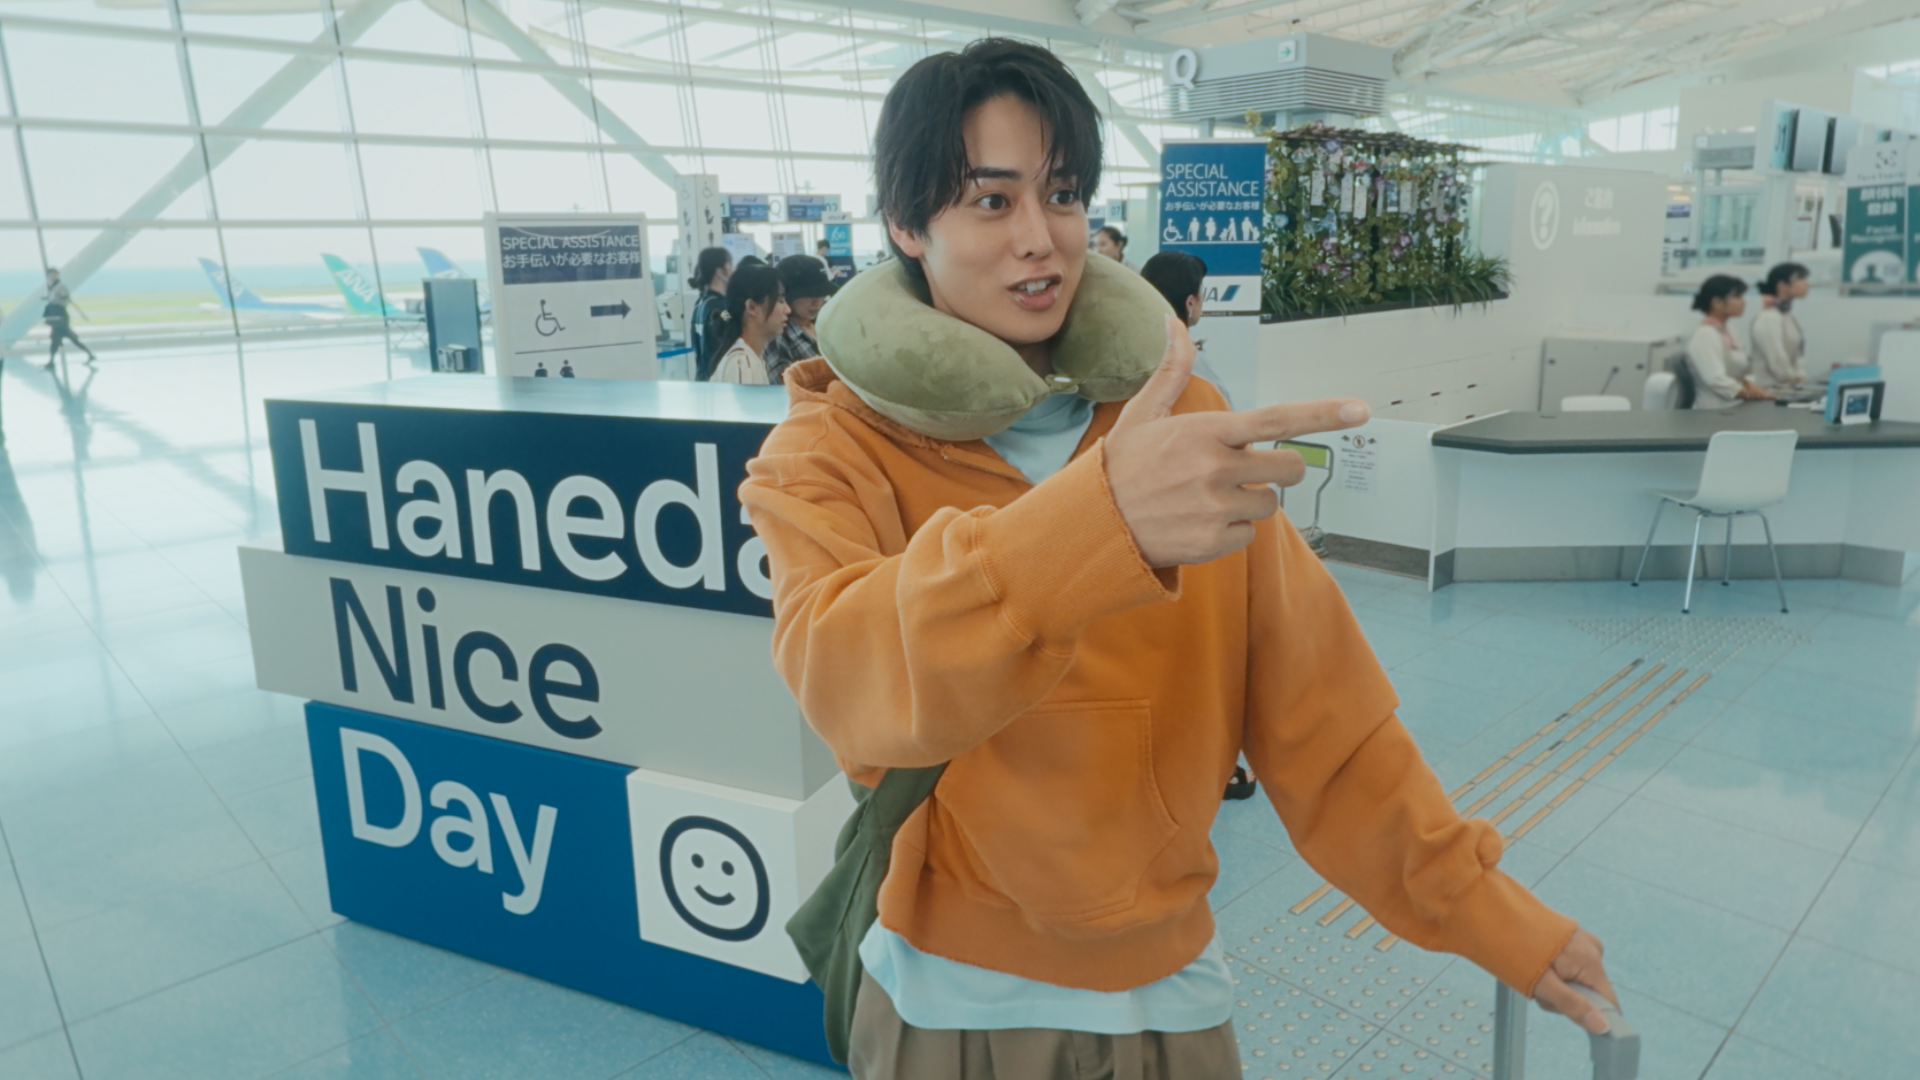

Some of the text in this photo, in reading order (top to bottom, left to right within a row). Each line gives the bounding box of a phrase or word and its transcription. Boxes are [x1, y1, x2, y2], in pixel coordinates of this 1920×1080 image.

[1170, 48, 1196, 90] Q
[1166, 163, 1228, 180] SPECIAL
[1165, 181, 1259, 197] ASSISTANCE
[770, 199, 782, 219] Q
[1165, 201, 1260, 211] お手伝いが必要なお客様
[502, 234, 639, 250] SPECIAL ASSISTANCE
[1850, 233, 1905, 244] Recognitio
[503, 250, 642, 269] お手伝いが必要なお客様
[335, 268, 376, 304] ANA
[329, 577, 603, 740] Nice
[339, 726, 558, 916] Day
